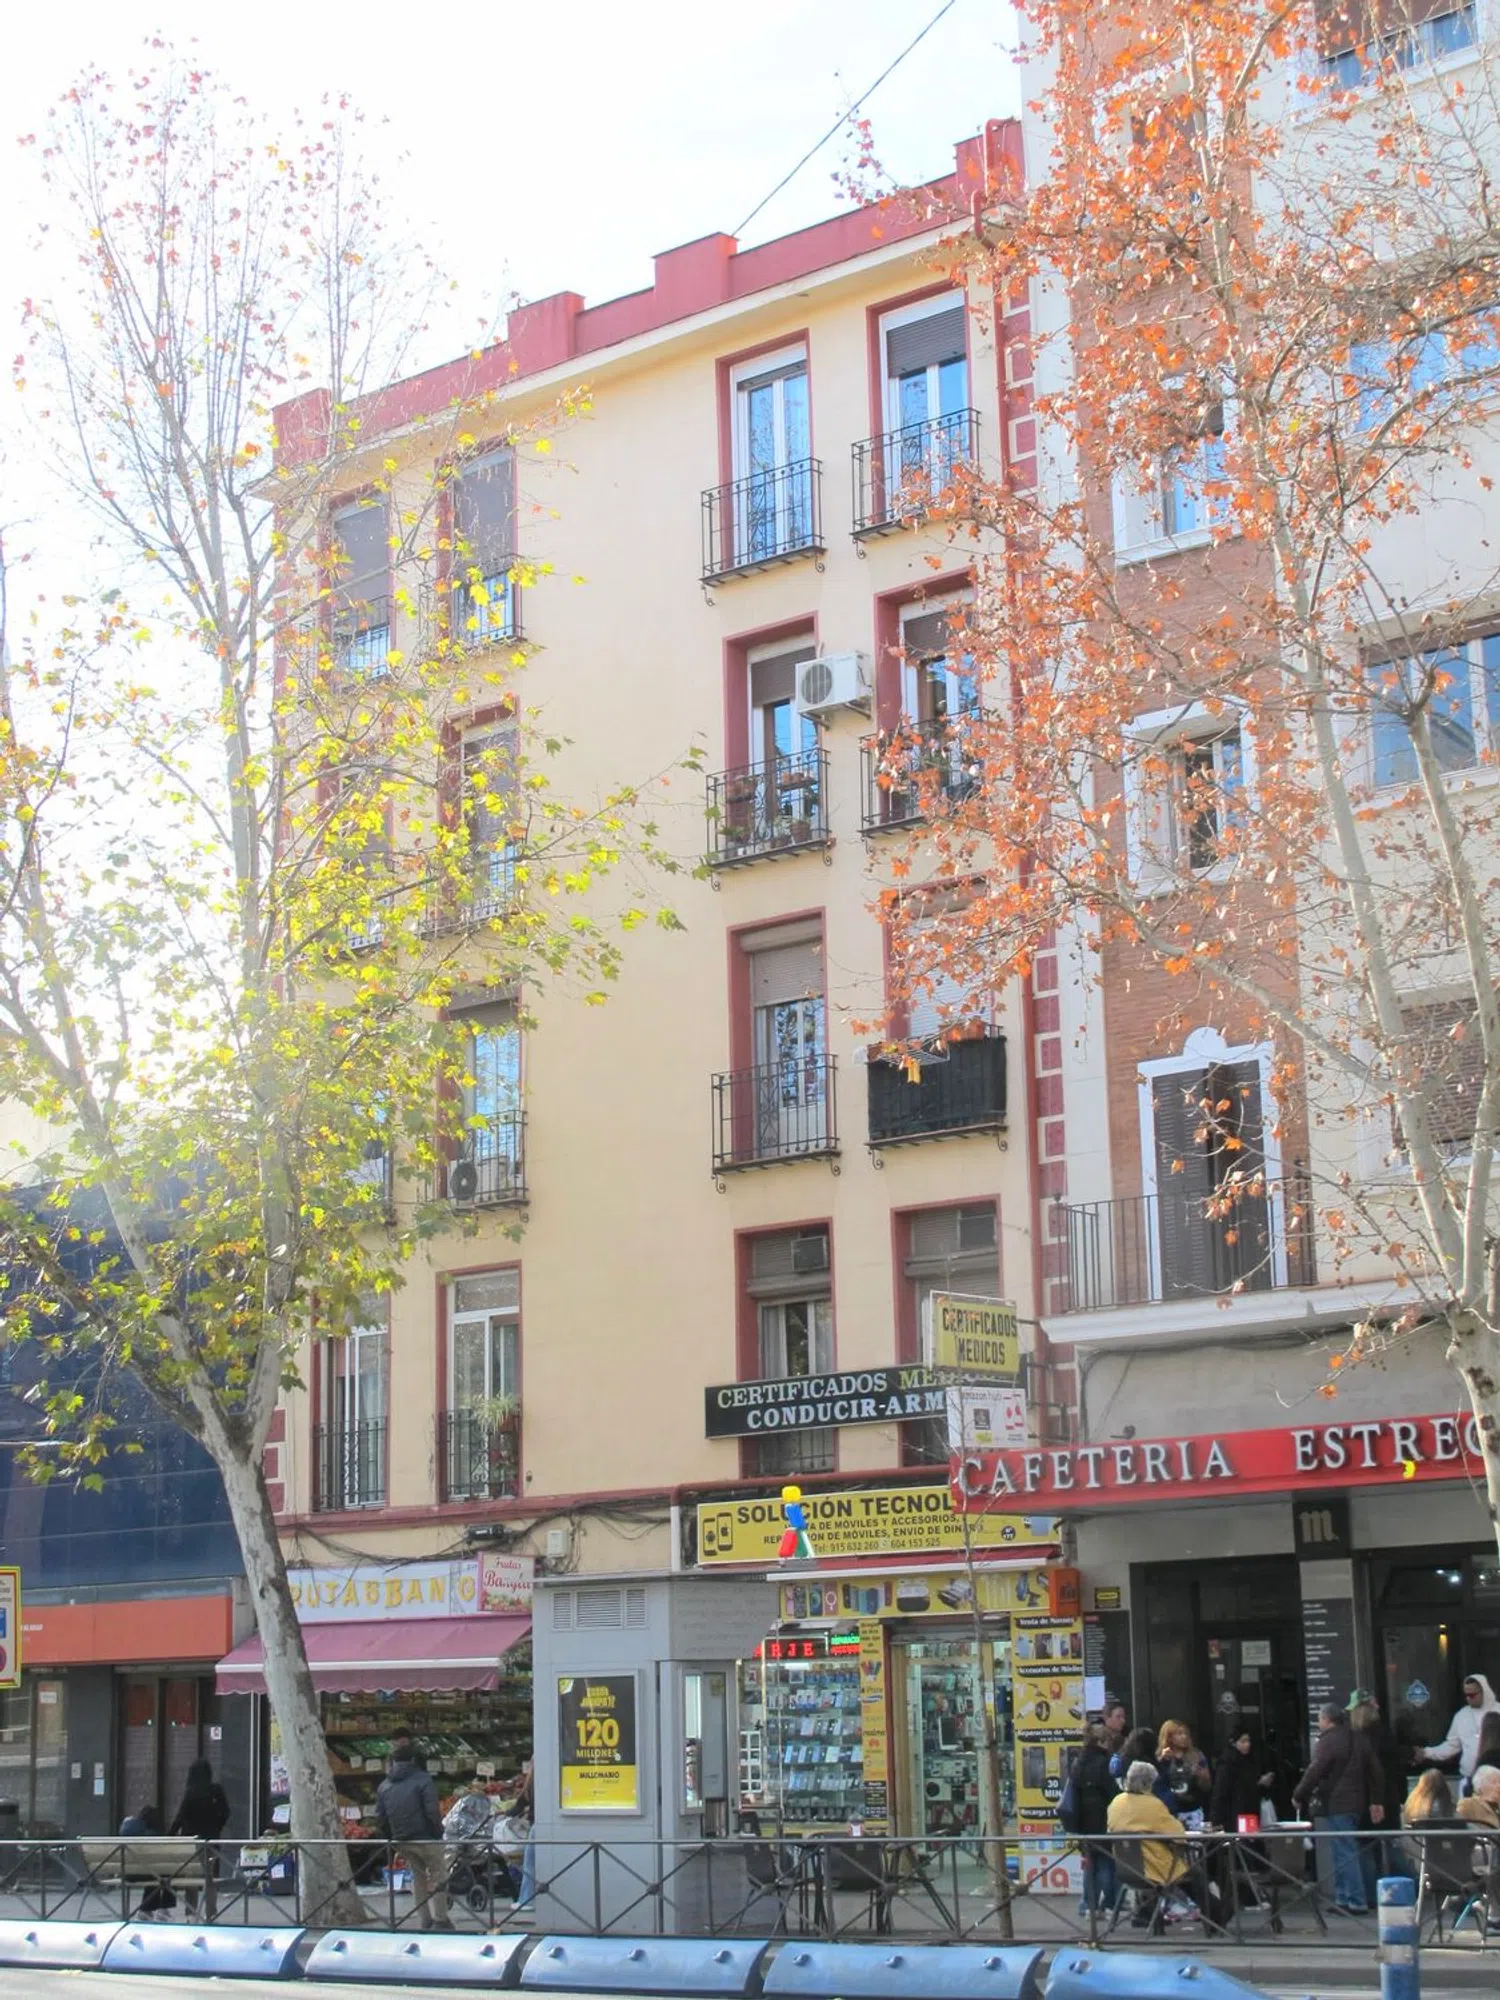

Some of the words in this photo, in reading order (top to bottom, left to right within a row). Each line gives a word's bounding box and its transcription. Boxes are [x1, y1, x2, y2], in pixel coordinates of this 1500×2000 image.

[942, 1307, 1017, 1338] CERTIFICADOS
[717, 1372, 888, 1408] CERTIFICADOS
[957, 1439, 1234, 1497] CAFETERIA
[819, 1520, 832, 1530] DE
[882, 1518, 888, 1527] Y
[828, 1531, 841, 1541] DE
[927, 1526, 941, 1536] DE
[576, 1718, 619, 1748] 120
[1047, 1779, 1059, 1788] 30
[1026, 1856, 1070, 1888] ria
